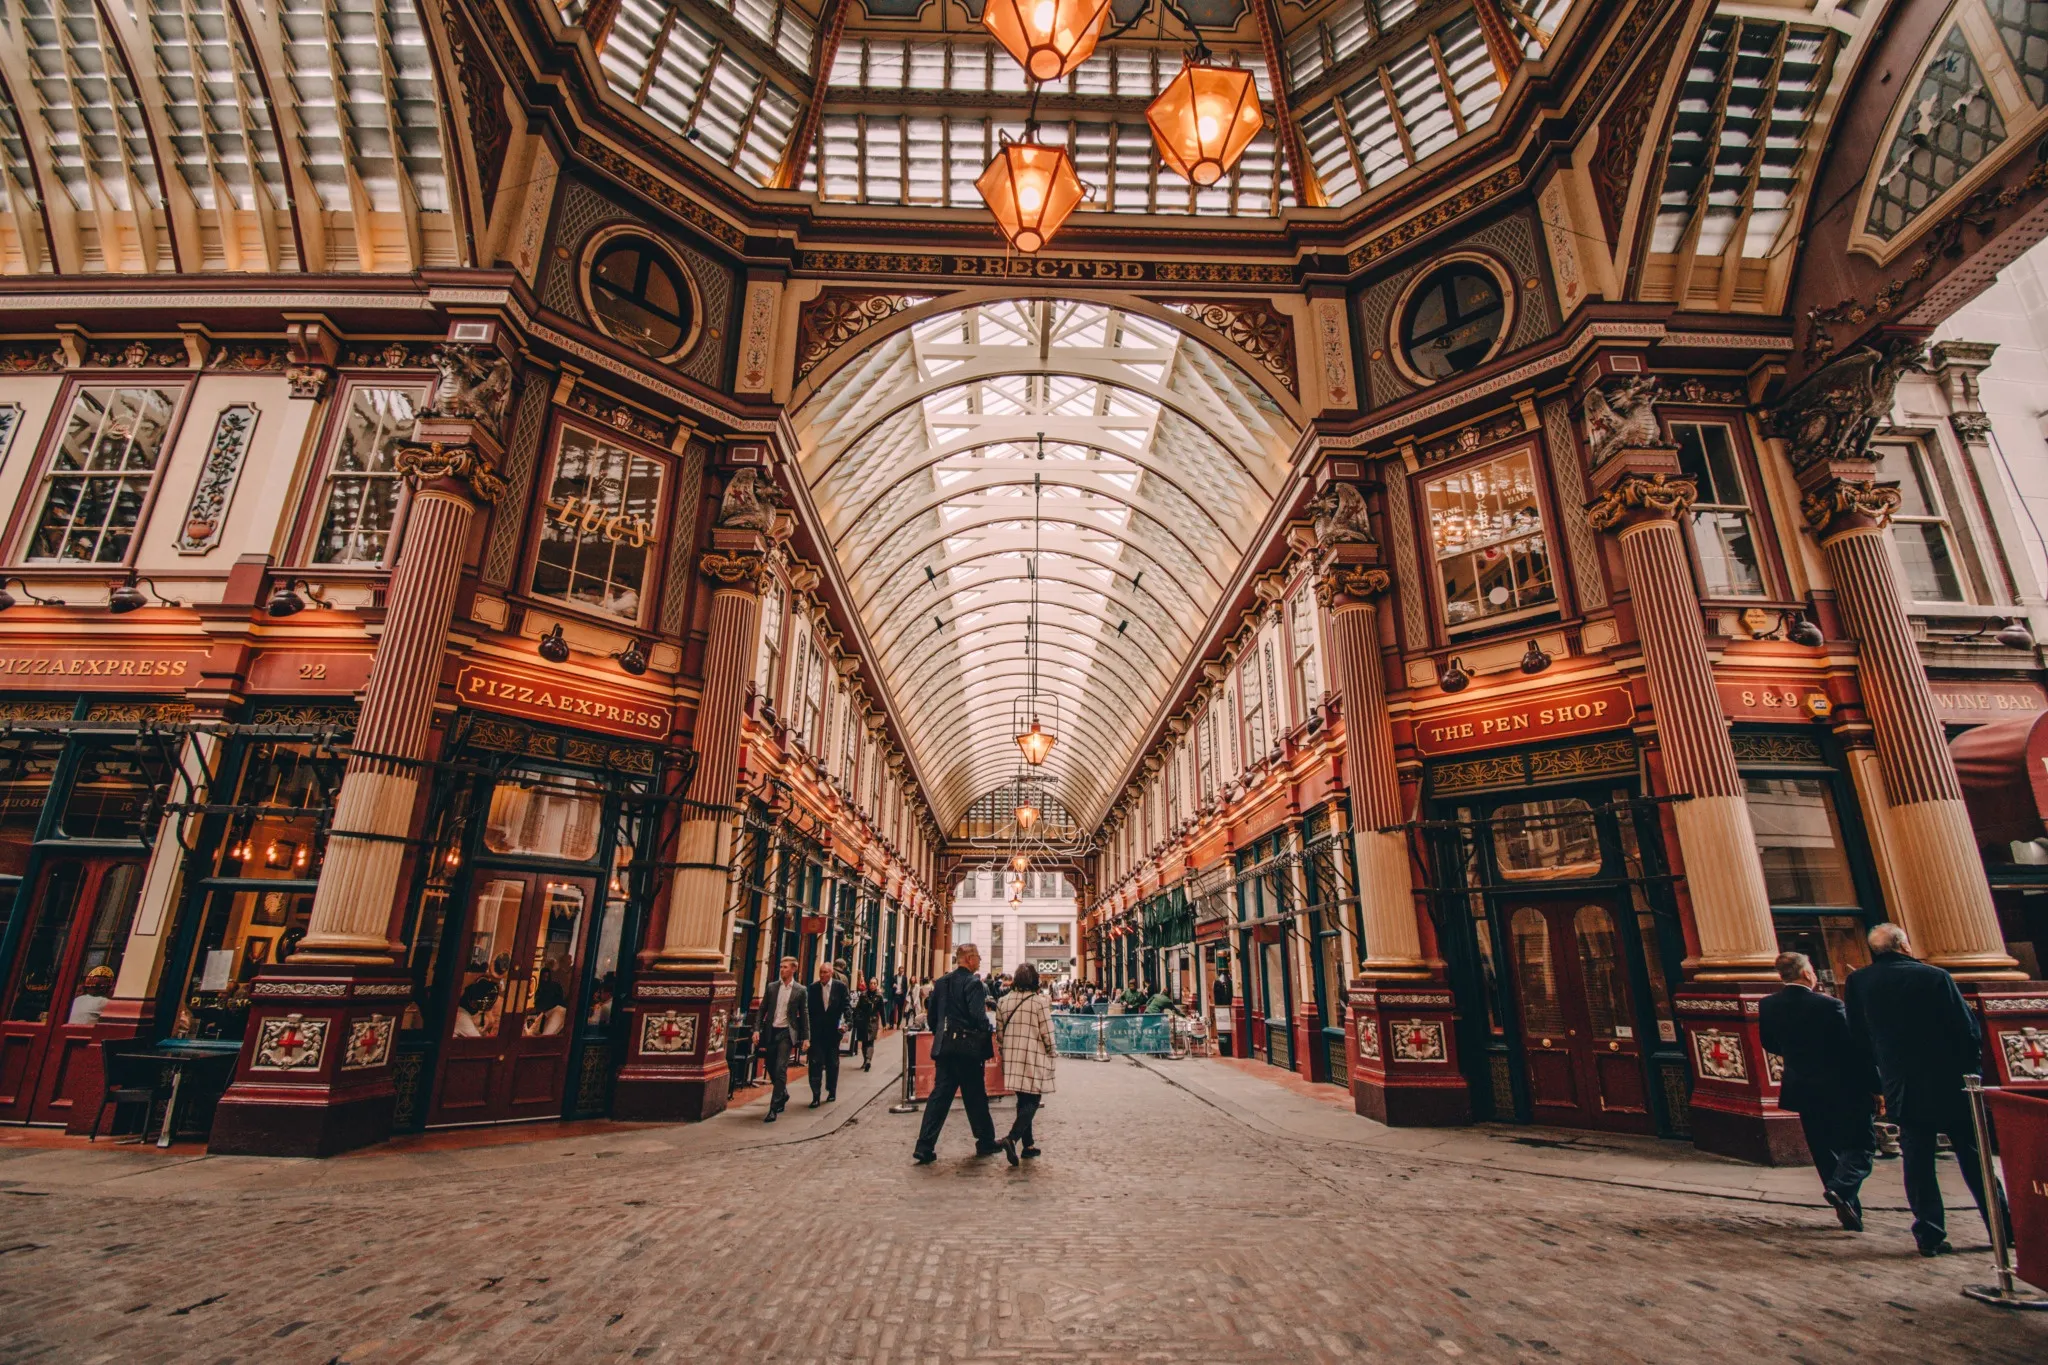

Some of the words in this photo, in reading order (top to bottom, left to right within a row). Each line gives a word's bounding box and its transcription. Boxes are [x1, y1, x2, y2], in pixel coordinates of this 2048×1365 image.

[952, 256, 1145, 280] ERECTED
[1508, 493, 1528, 505] BAR
[555, 495, 650, 548] LUC'S
[300, 663, 326, 679] 22
[469, 676, 662, 729] PIZZAEXPRESS
[1742, 691, 1756, 707] 8
[1763, 691, 1781, 707] &
[1784, 692, 1798, 708] 9
[1934, 693, 1991, 709] WINE
[1994, 694, 2038, 710] BAR
[1431, 723, 1474, 742] THE
[1481, 713, 1529, 734] PEN
[1539, 701, 1608, 725] SHOP
[1038, 960, 1058, 972] pod
